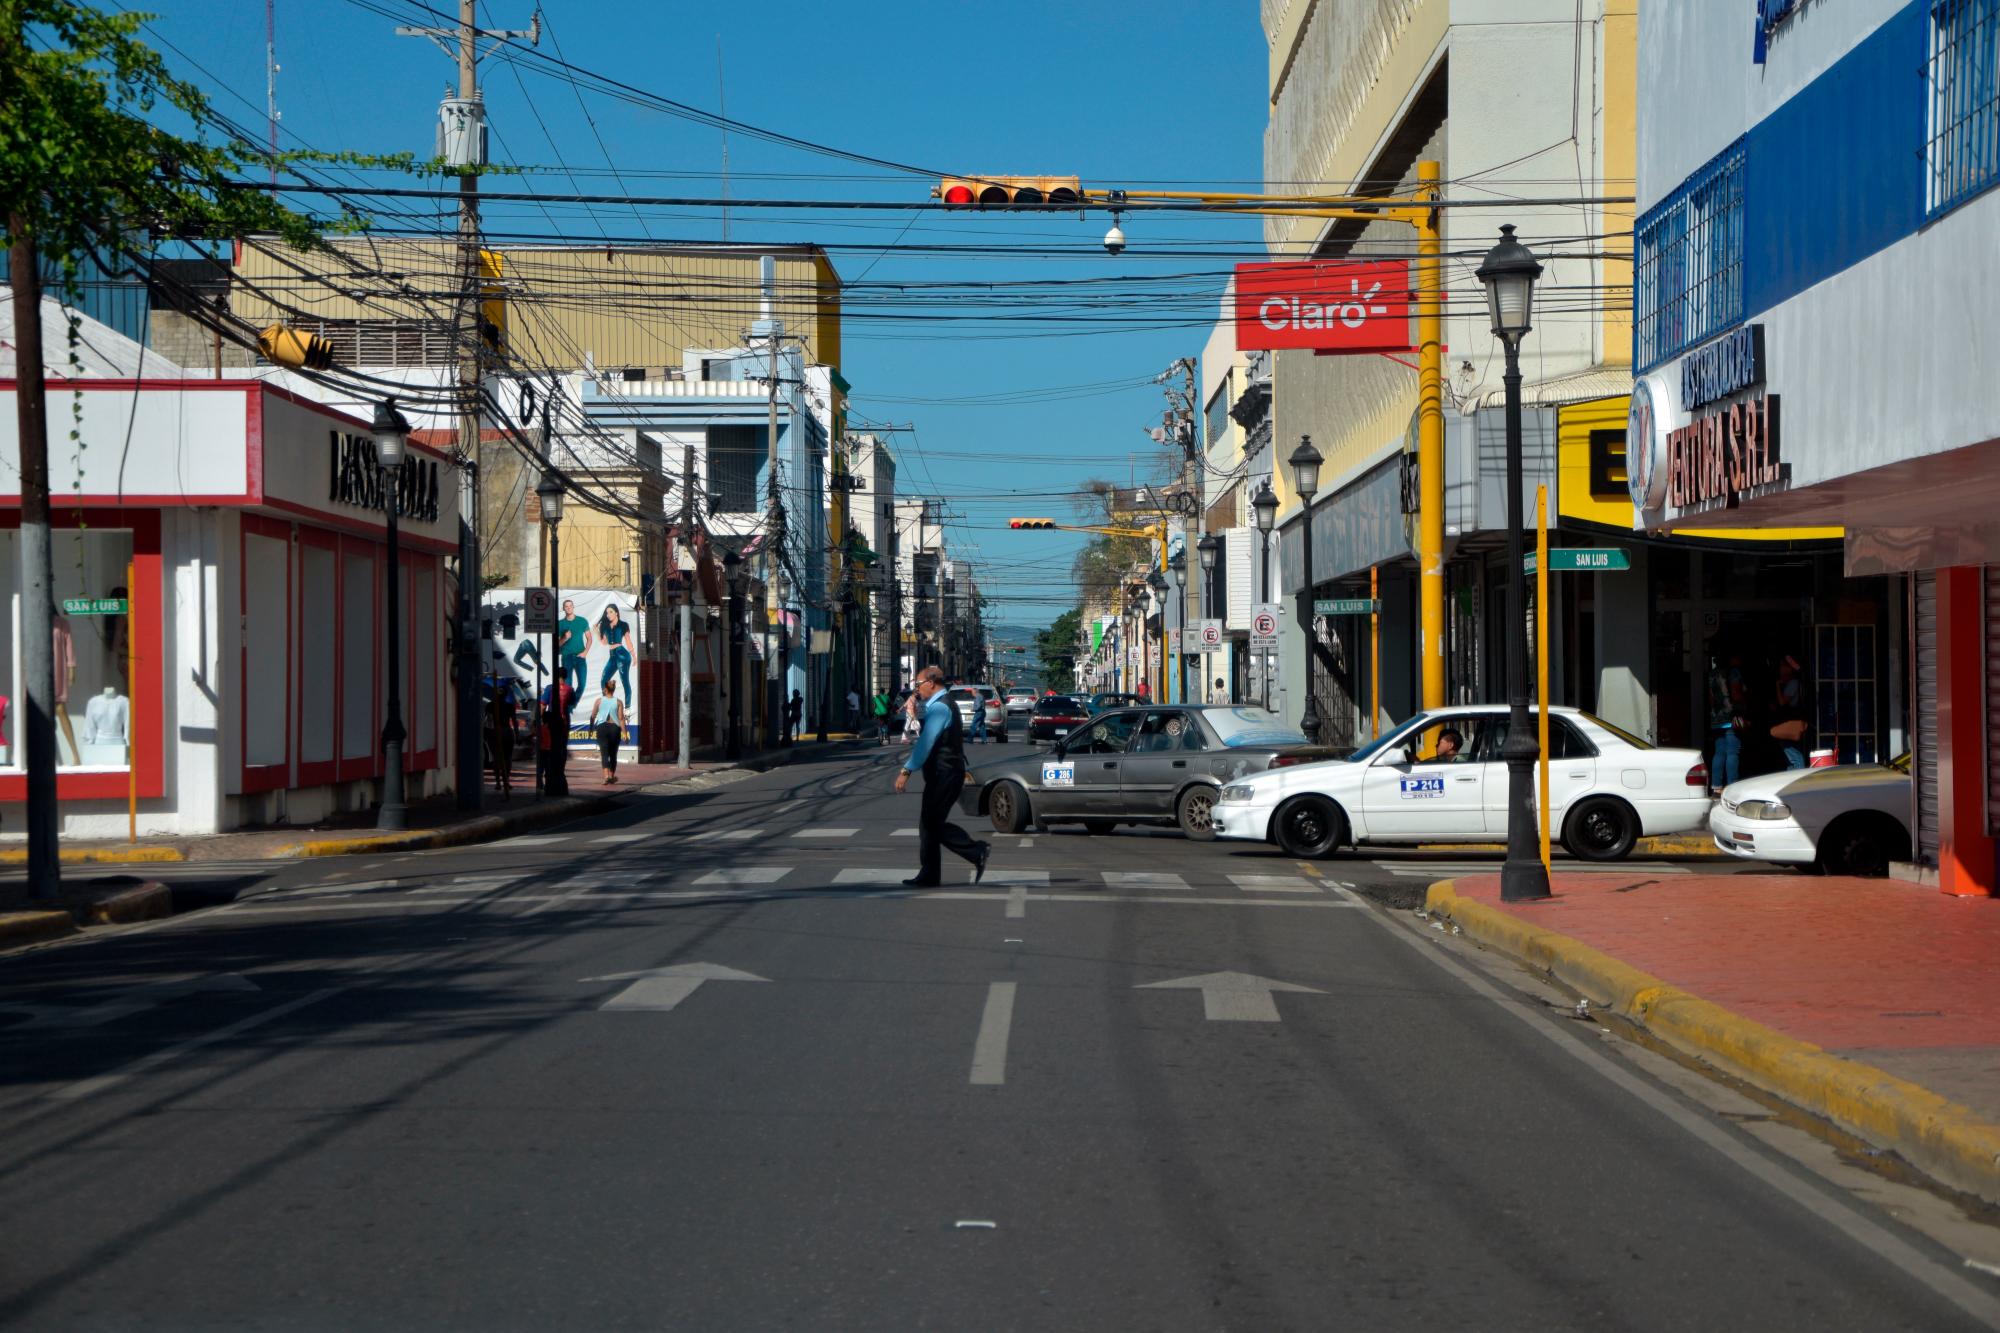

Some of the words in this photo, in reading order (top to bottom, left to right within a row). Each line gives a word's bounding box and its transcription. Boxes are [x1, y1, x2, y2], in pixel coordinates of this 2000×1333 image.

[1681, 326, 1754, 411] DISTRIBUIDORA
[1576, 554, 1590, 566] SAN
[1592, 553, 1608, 566] LUIS
[67, 602, 89, 611] SAN
[1317, 603, 1337, 612] SAN
[1340, 602, 1364, 611] LUIS
[1046, 770, 1056, 780] G
[1406, 780, 1418, 792] P
[1421, 780, 1439, 790] 214
